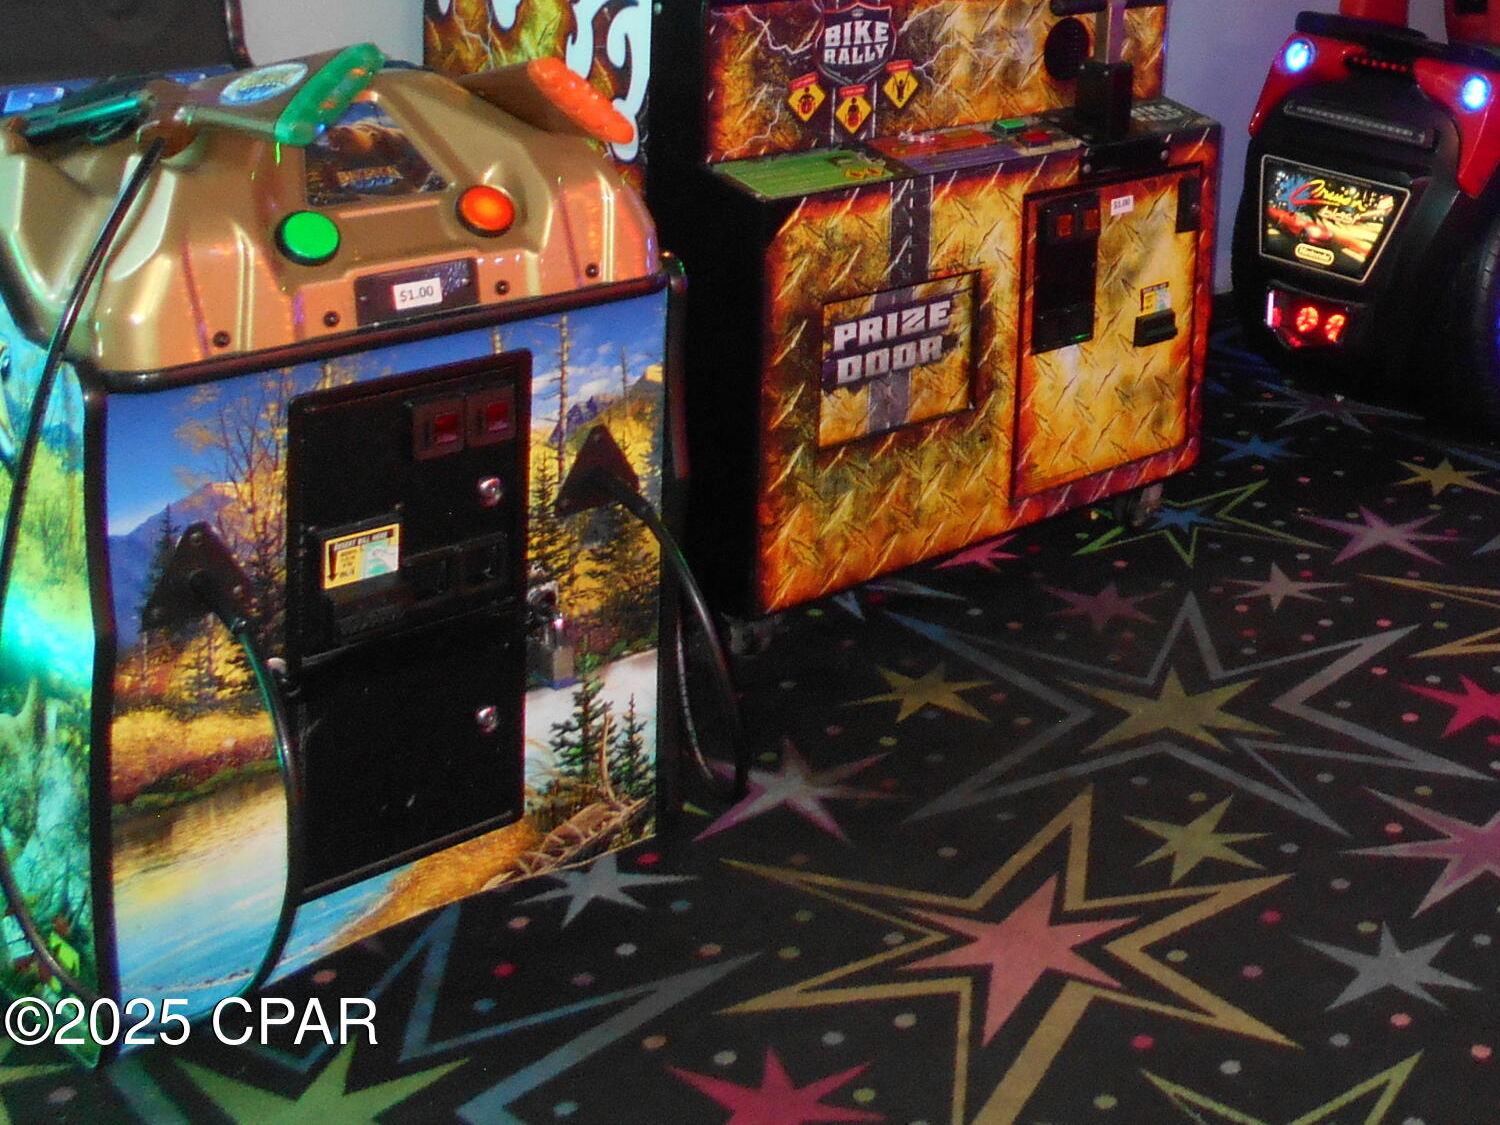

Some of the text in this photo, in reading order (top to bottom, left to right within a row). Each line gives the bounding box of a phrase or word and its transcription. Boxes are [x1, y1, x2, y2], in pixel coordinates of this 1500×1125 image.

[825, 19, 889, 47] BIKE
[824, 43, 888, 65] RALLY
[400, 285, 434, 302] $1.00
[834, 300, 951, 352] PRIZE
[837, 335, 943, 384] DOOR
